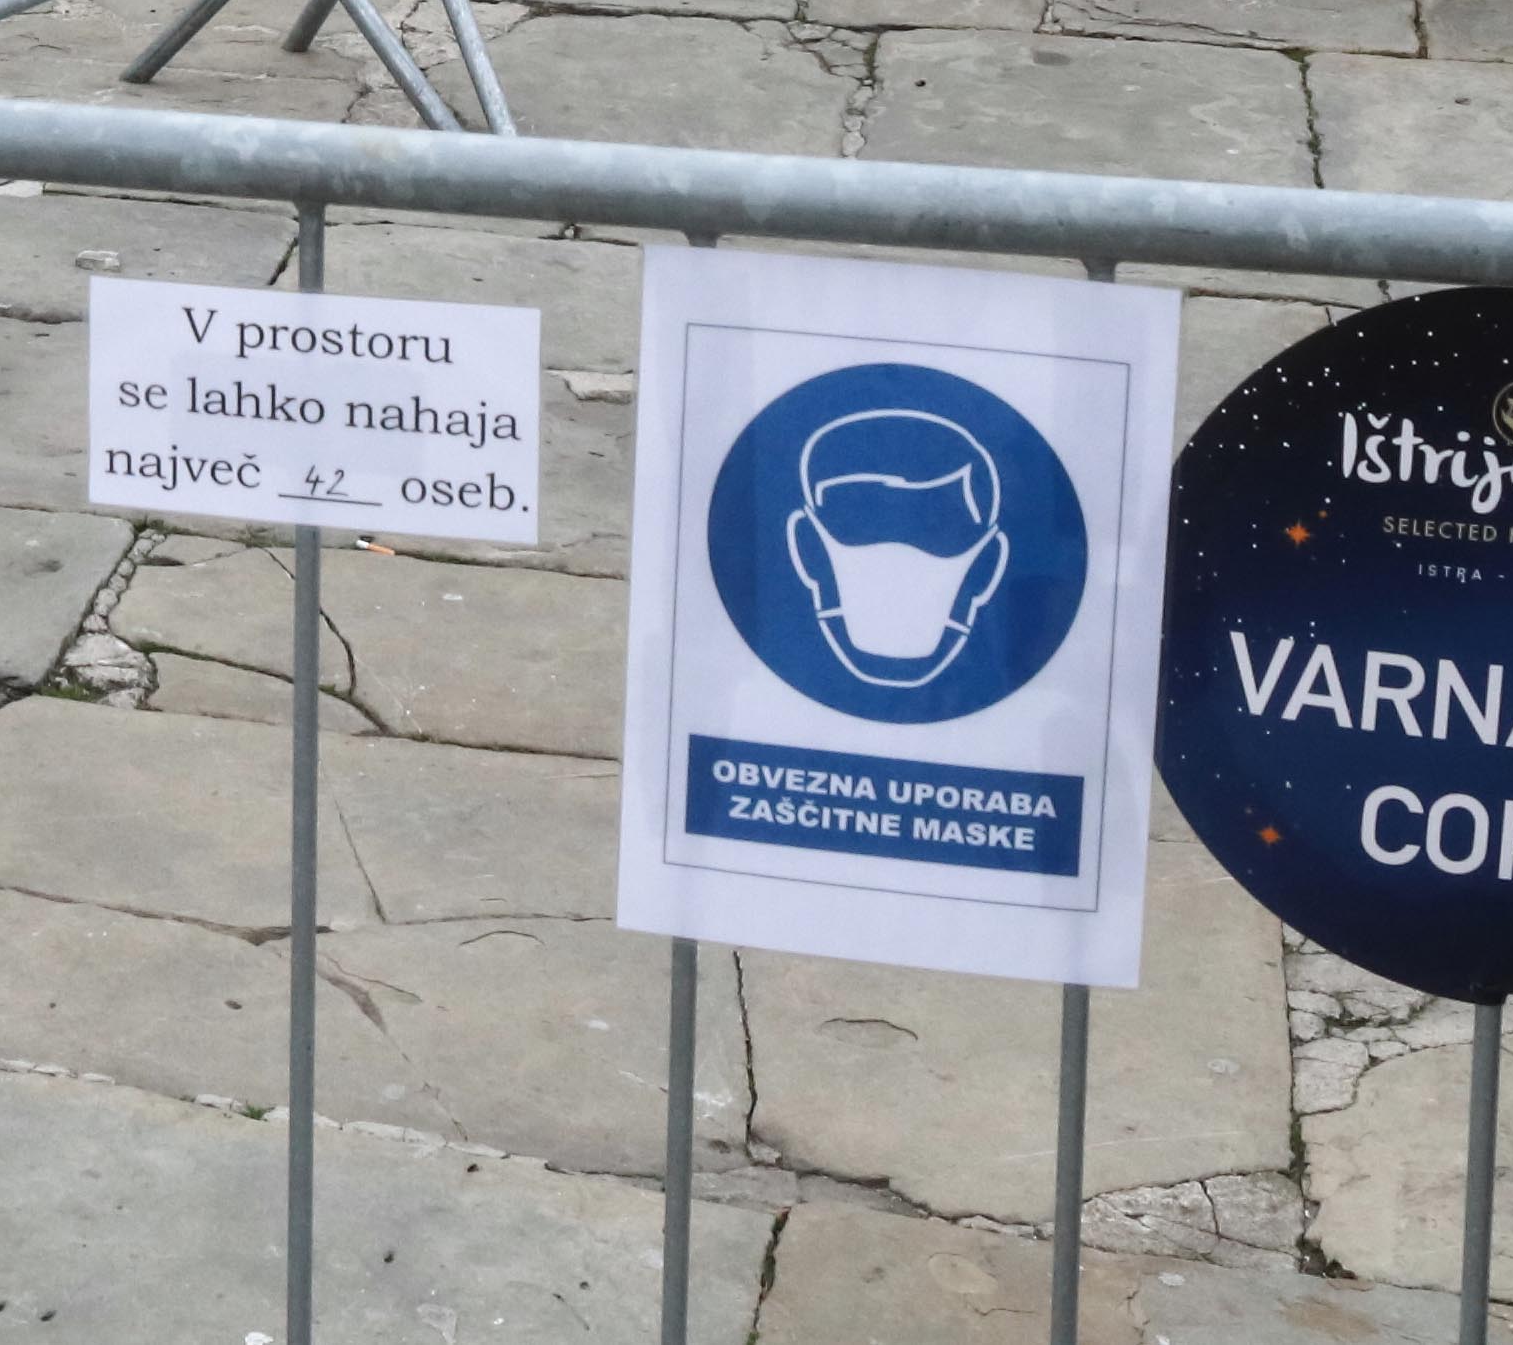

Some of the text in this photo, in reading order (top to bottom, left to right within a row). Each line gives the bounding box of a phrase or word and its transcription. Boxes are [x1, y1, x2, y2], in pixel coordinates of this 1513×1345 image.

[181, 306, 455, 365] V prostoru
[117, 377, 522, 449] se lahko nahaja
[104, 444, 530, 513] največ 42 oseb.
[1382, 515, 1498, 543] SELECTED
[1417, 563, 1483, 583] ISTRA
[712, 759, 1058, 819] OBVEZNA UPORABA
[728, 794, 1036, 852] ZAŠČITNE MASKE
